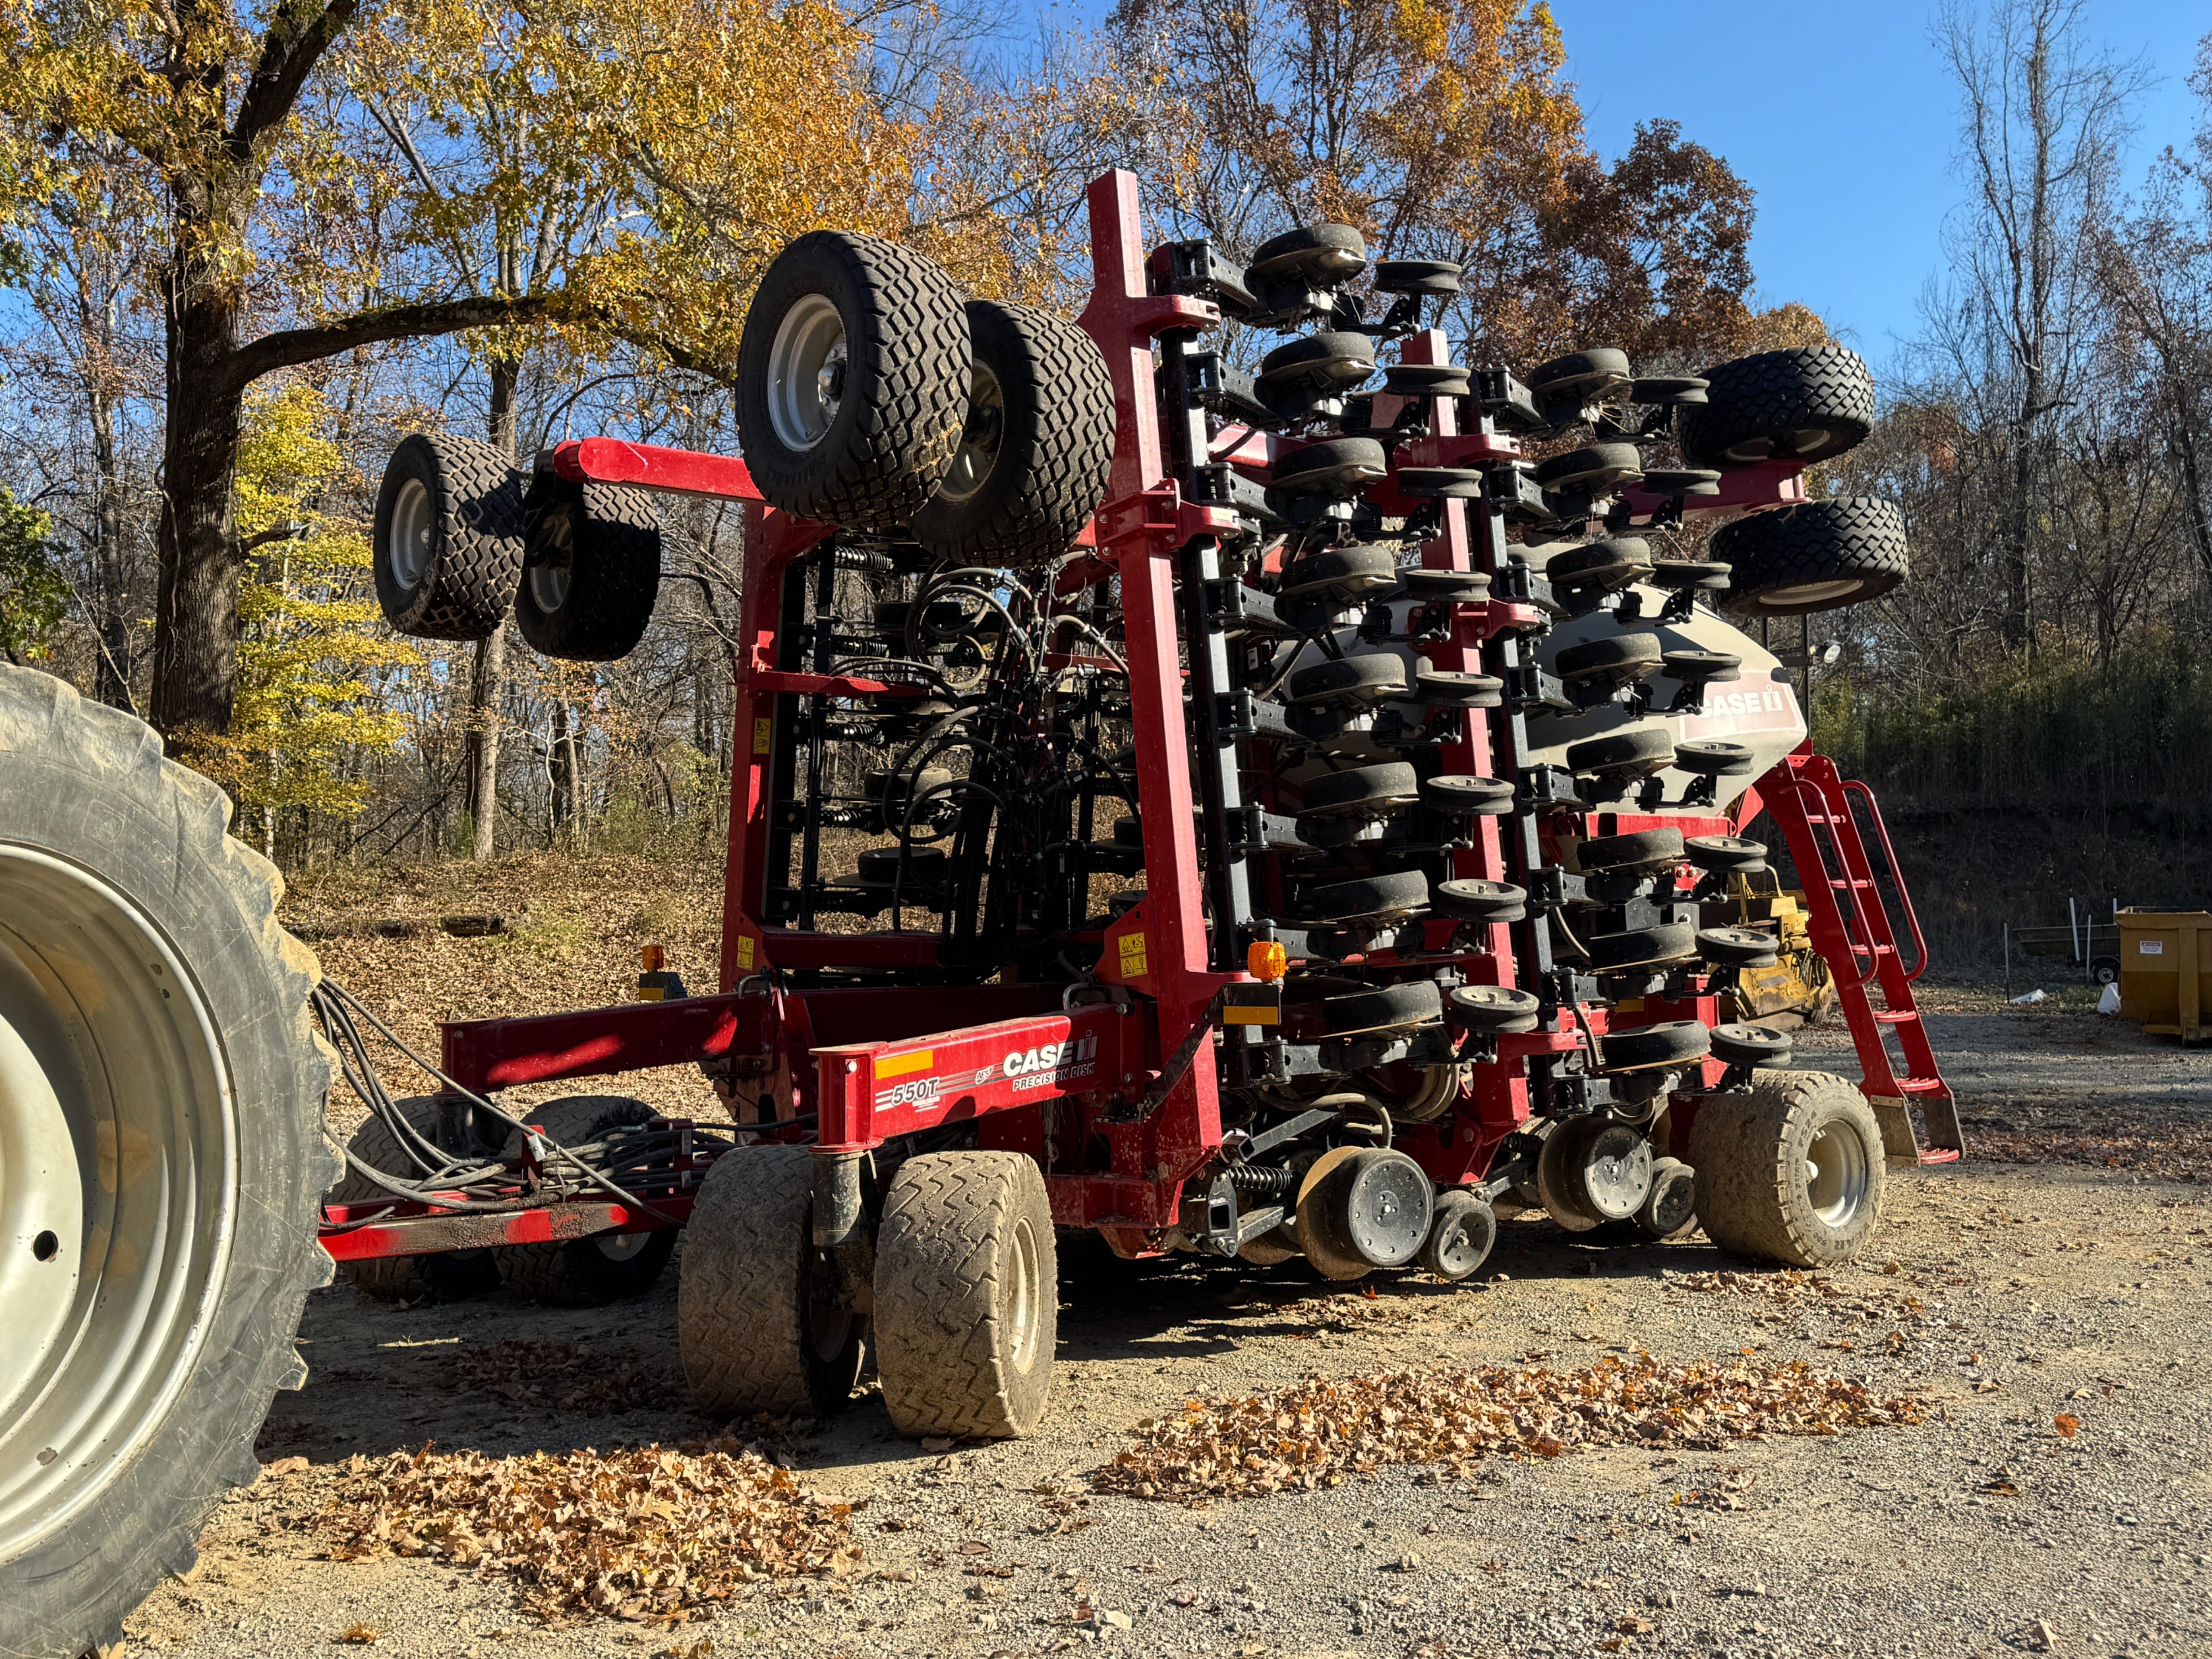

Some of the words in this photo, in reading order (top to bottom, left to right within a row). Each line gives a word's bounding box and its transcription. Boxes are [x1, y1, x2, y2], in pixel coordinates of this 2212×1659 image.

[1701, 692, 1763, 718] CASE
[1003, 1041, 1074, 1077] CASE
[1012, 1068, 1069, 1092] PRECISION
[1070, 1062, 1095, 1078] DISK
[892, 1078, 939, 1105] 550T
